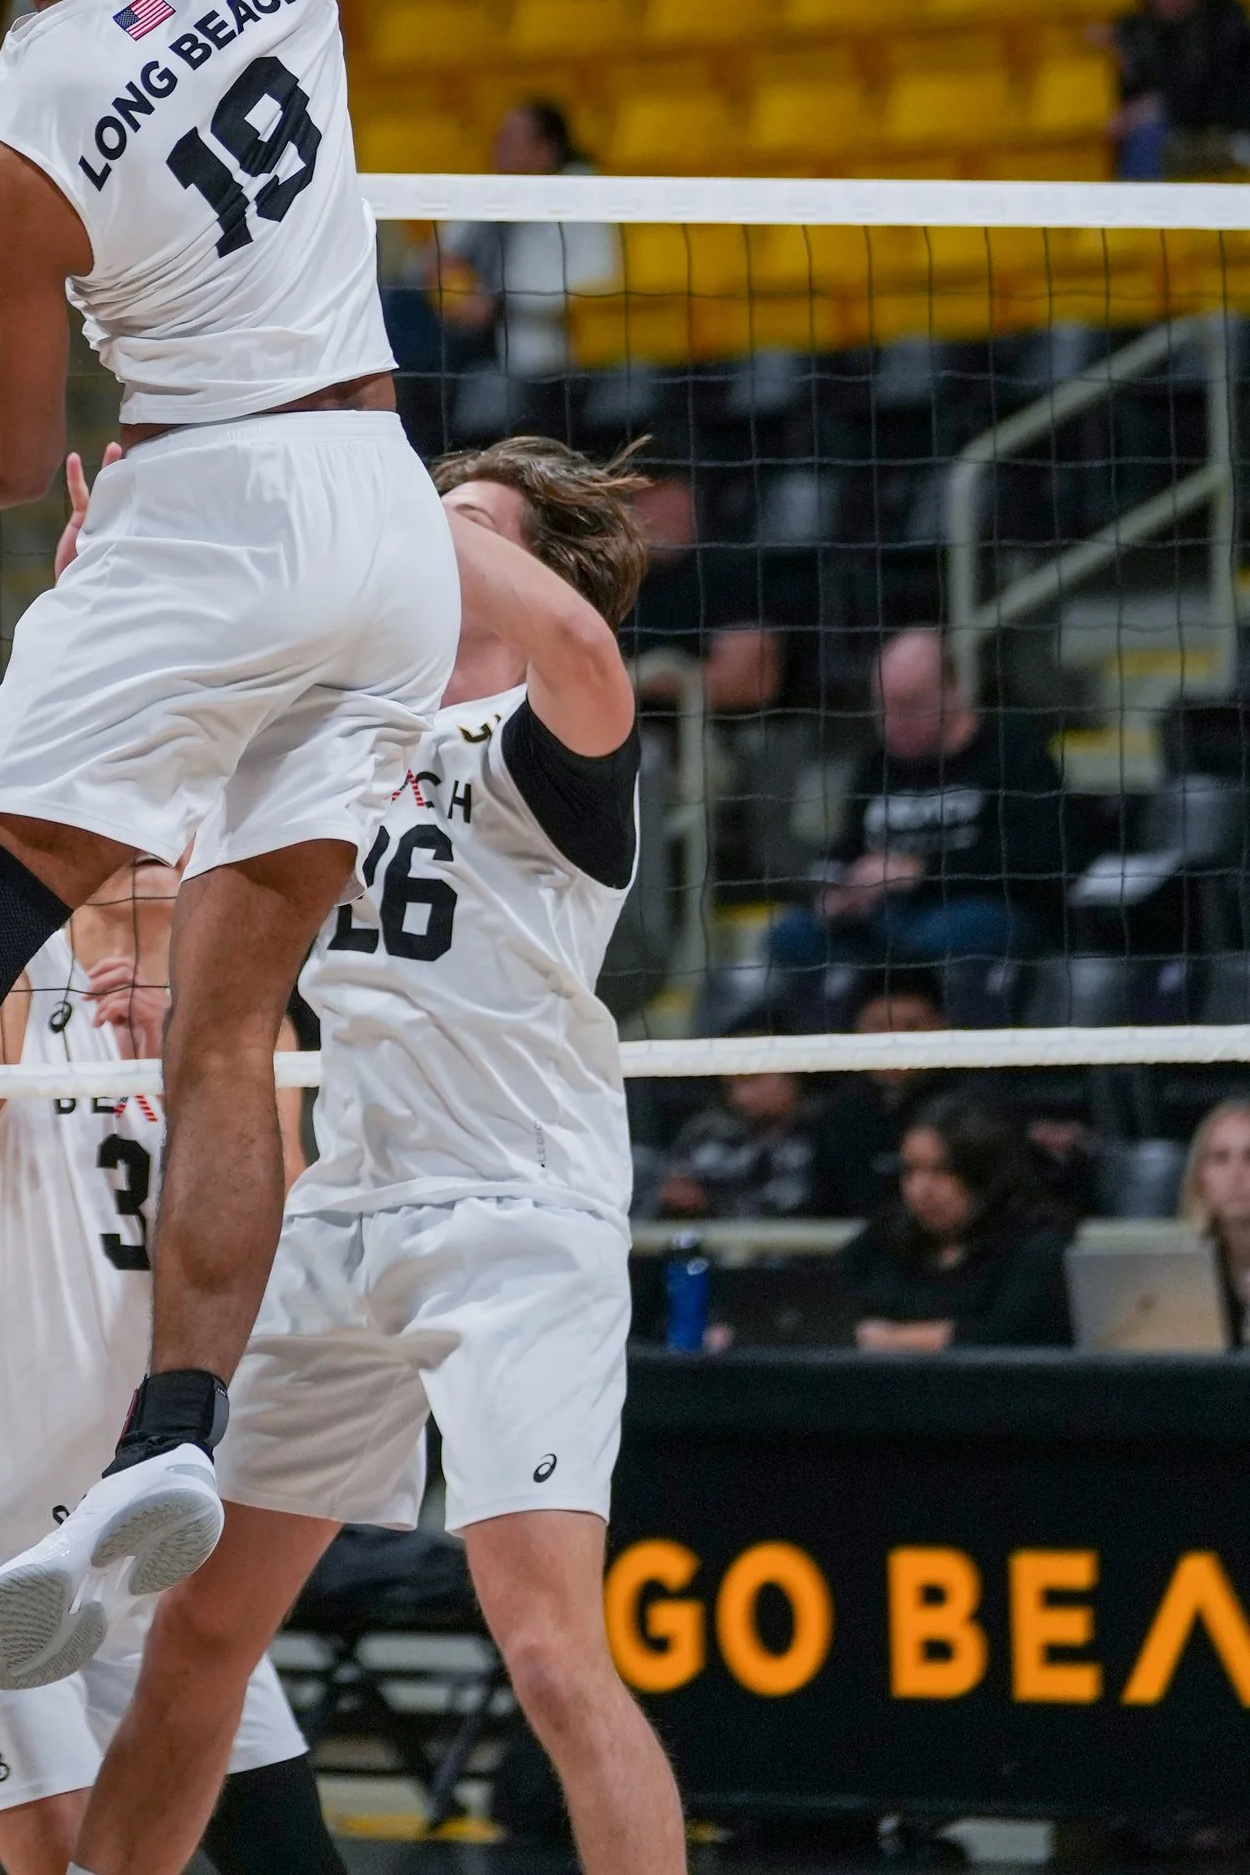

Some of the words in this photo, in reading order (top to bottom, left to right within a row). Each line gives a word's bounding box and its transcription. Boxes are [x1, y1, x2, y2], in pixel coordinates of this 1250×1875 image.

[78, 60, 178, 192] LONG
[165, 56, 323, 259] 19
[603, 1538, 834, 1698] GO
